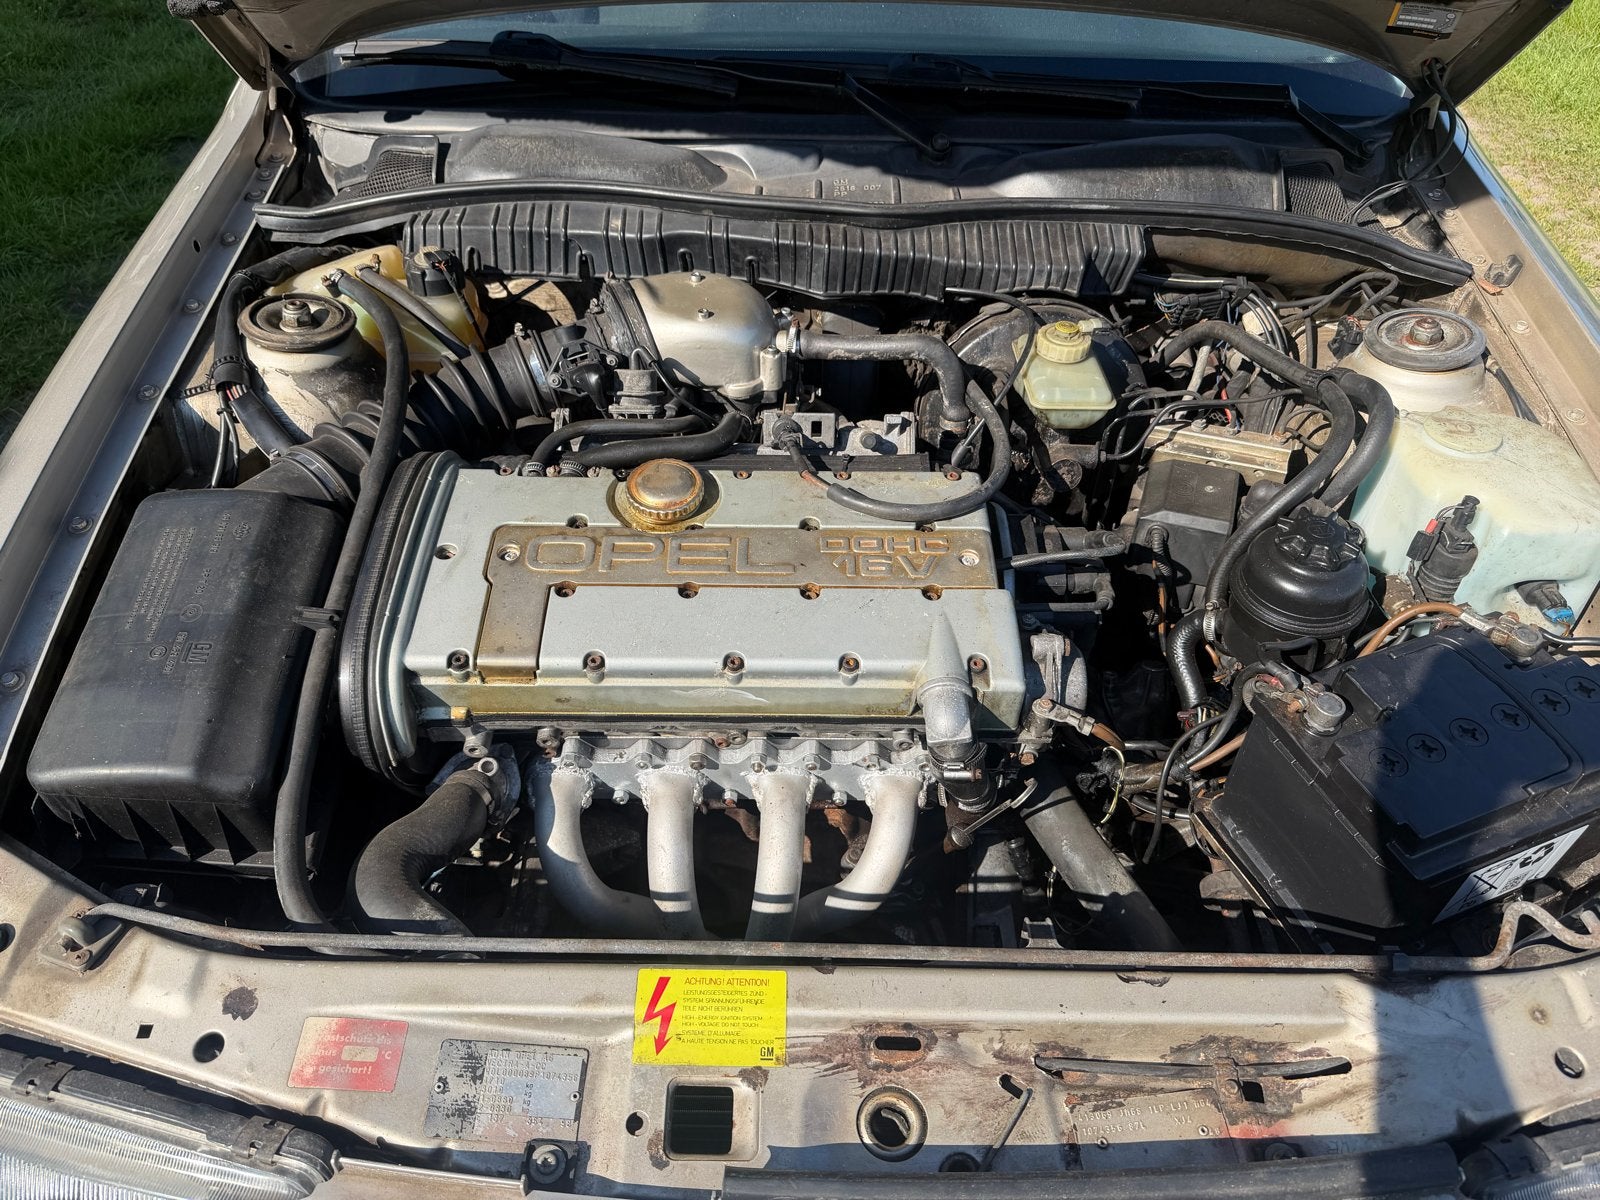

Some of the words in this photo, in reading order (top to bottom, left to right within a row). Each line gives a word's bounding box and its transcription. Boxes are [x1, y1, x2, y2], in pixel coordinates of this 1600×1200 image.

[820, 535, 951, 554] DOHC
[525, 534, 796, 575] OPEL
[832, 554, 938, 579] 16V
[188, 642, 214, 664] GM
[684, 977, 725, 986] ACHTUNG!
[726, 977, 770, 987] ATTENTION!
[760, 1046, 774, 1057] GM
[318, 1063, 372, 1075] gesichert!
[525, 1082, 534, 1090] kg
[523, 1099, 531, 1107] kg
